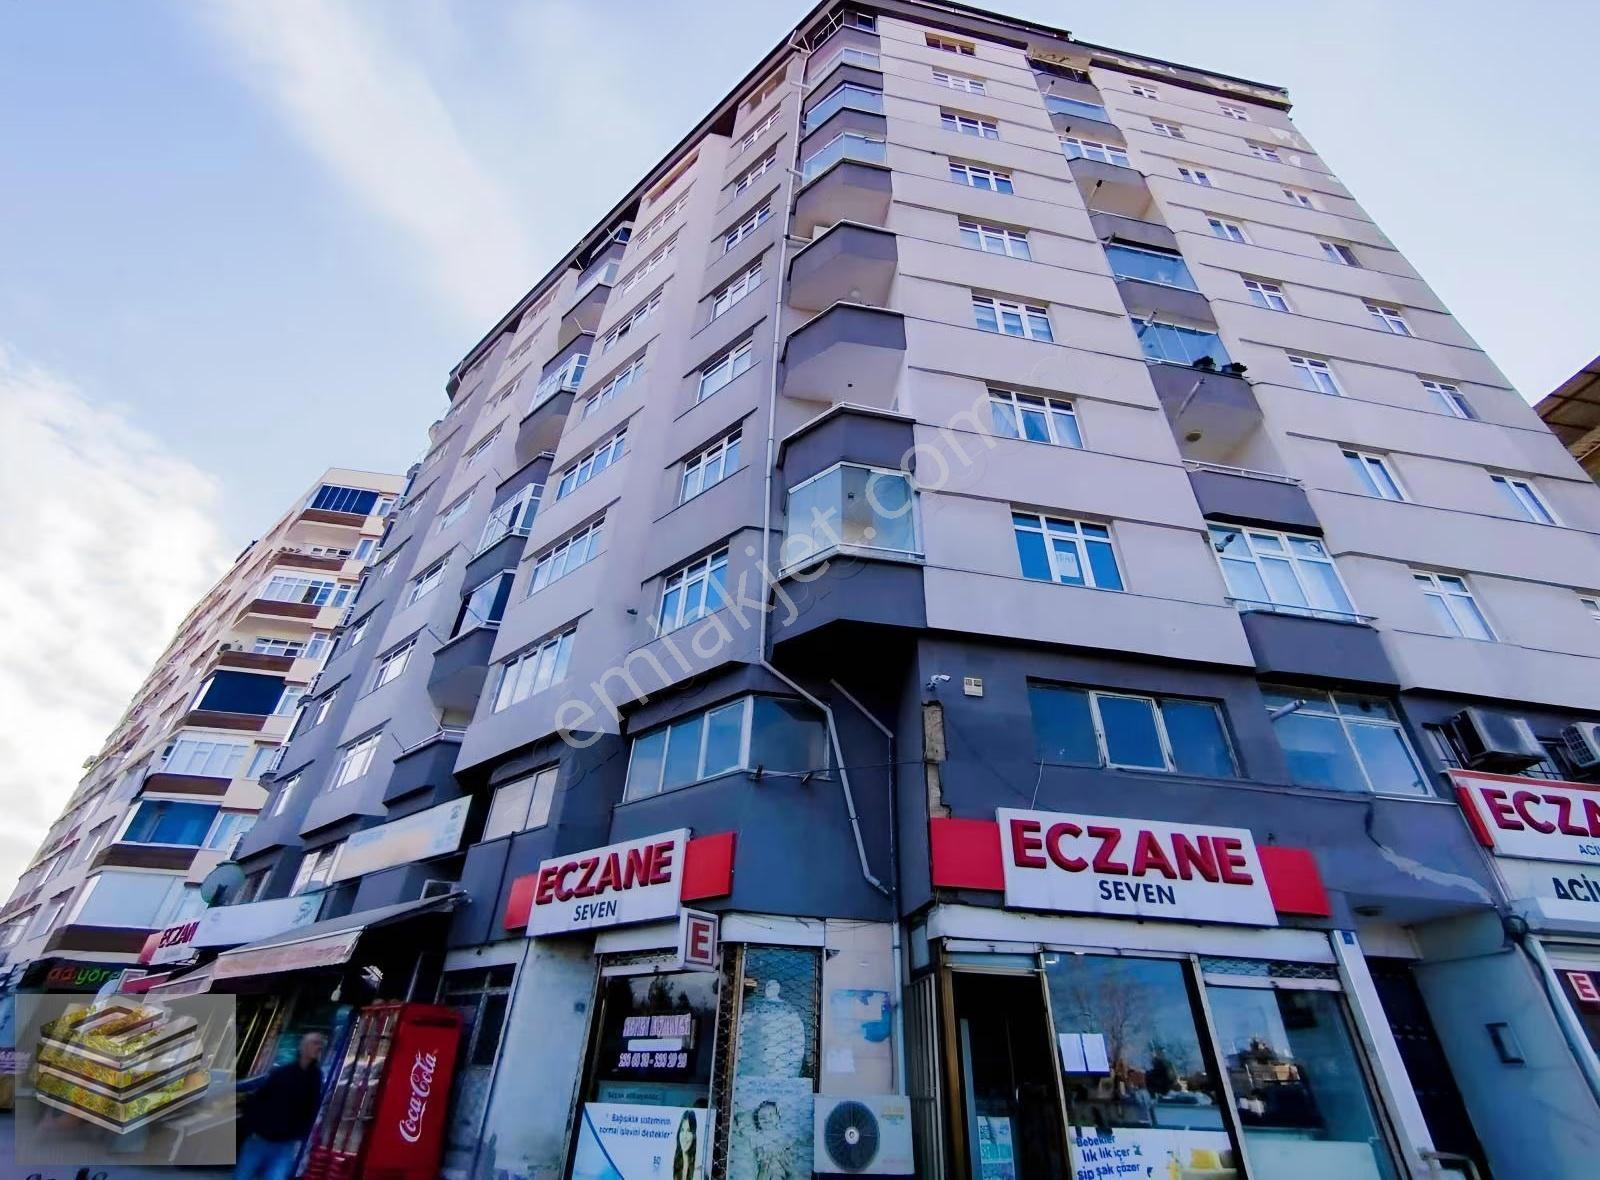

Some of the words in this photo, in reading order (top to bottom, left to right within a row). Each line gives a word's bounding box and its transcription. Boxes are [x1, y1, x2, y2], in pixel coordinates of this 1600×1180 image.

[1010, 819, 1254, 886] ECZANE
[535, 840, 675, 906] ECZANE
[1098, 879, 1176, 905] SEVEN
[573, 900, 617, 922] SEVEN
[691, 921, 709, 960] E
[1572, 975, 1596, 998] E
[399, 1050, 437, 1143] Coca-Cola
